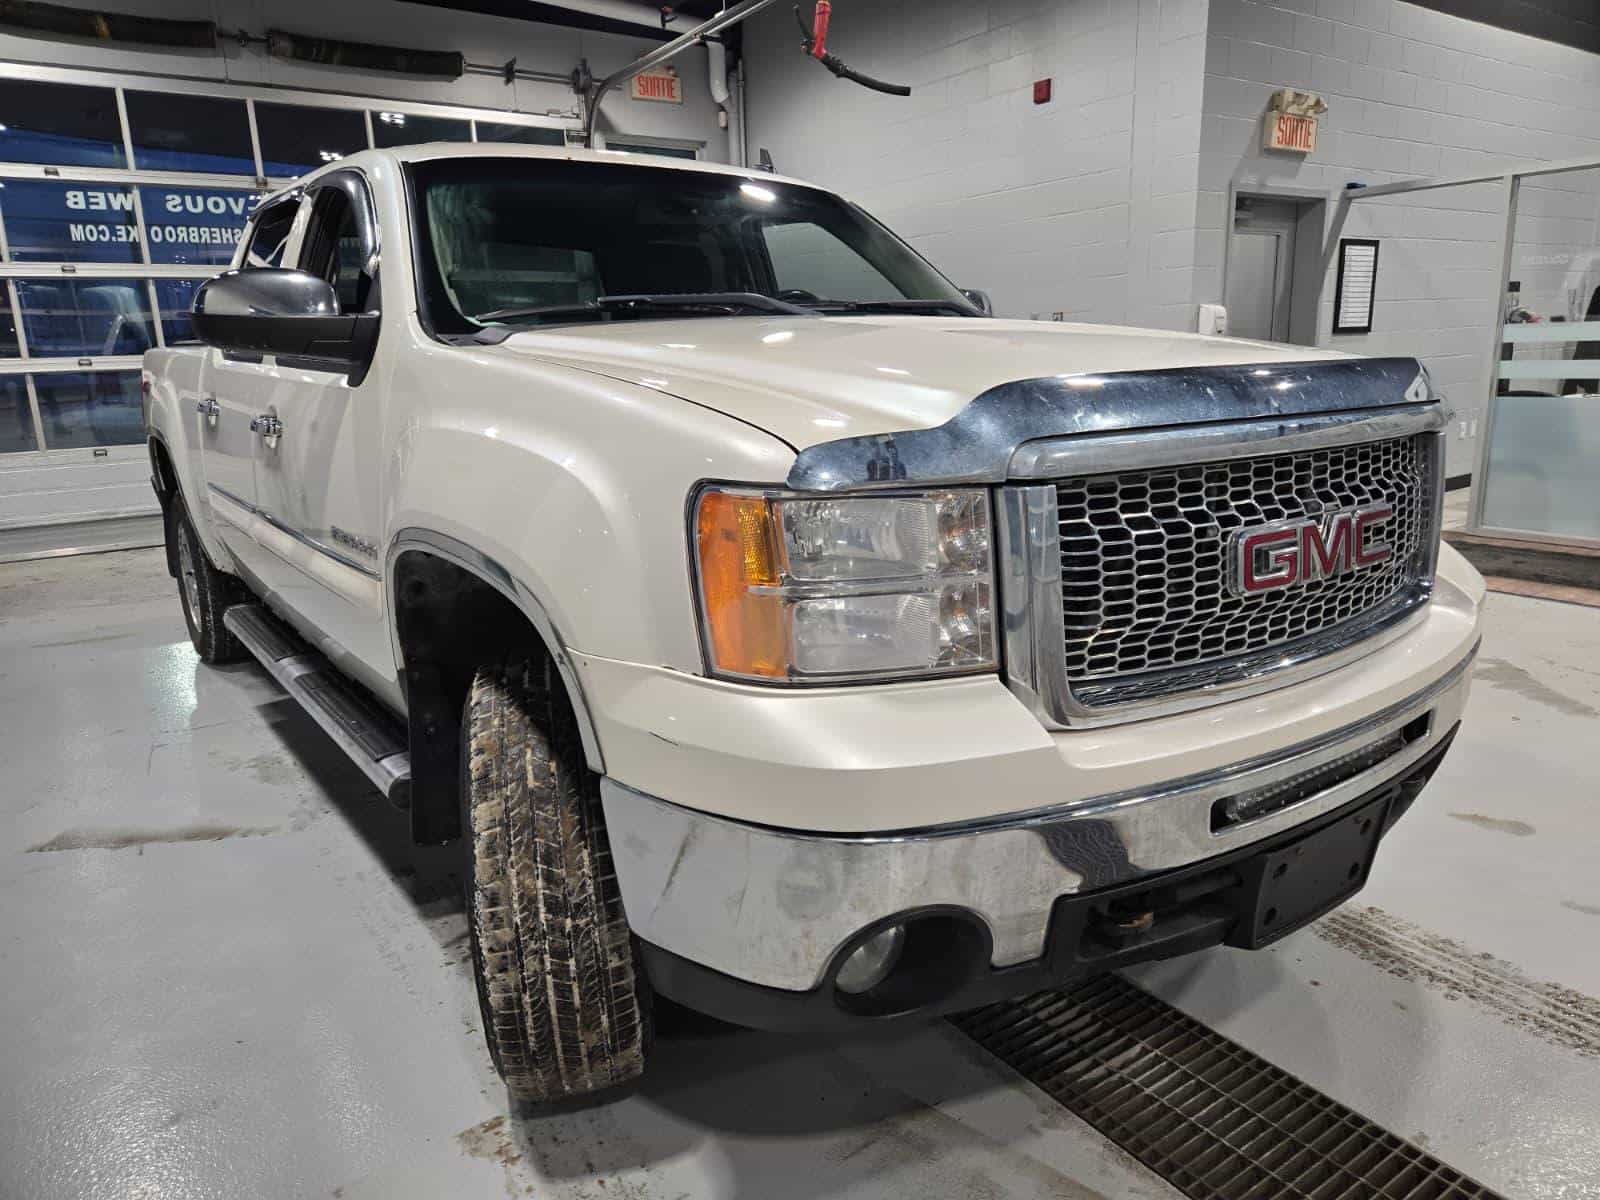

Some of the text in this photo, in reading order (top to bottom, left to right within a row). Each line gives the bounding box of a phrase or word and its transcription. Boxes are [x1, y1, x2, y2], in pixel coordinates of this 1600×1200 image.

[638, 75, 677, 98] SORTIE
[1277, 115, 1313, 148] SORTIE
[1238, 506, 1394, 596] GMC
